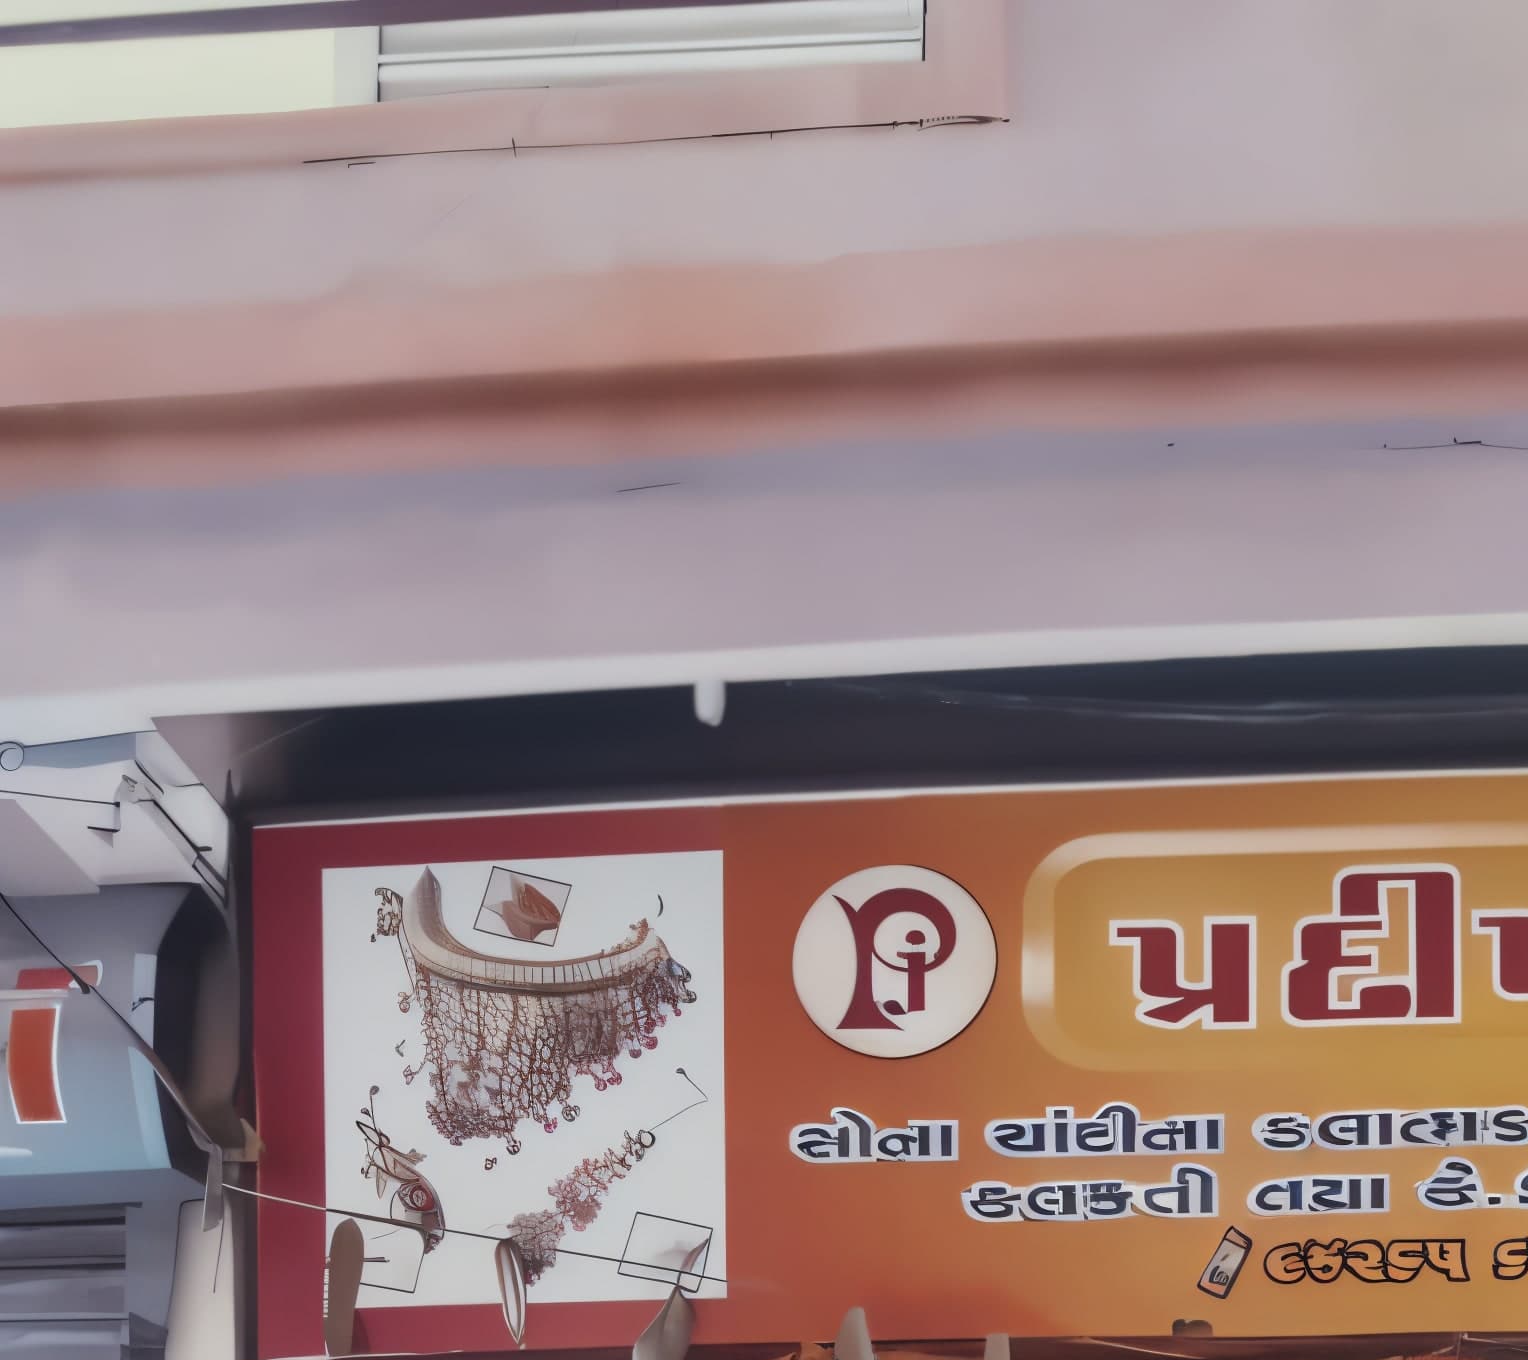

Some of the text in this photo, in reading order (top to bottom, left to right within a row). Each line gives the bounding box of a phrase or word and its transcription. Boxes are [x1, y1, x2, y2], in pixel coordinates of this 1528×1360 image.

[790, 1107, 959, 1162] સોના
[984, 1101, 1224, 1157] ચાંદીના
[1247, 1174, 1390, 1216] તથા
